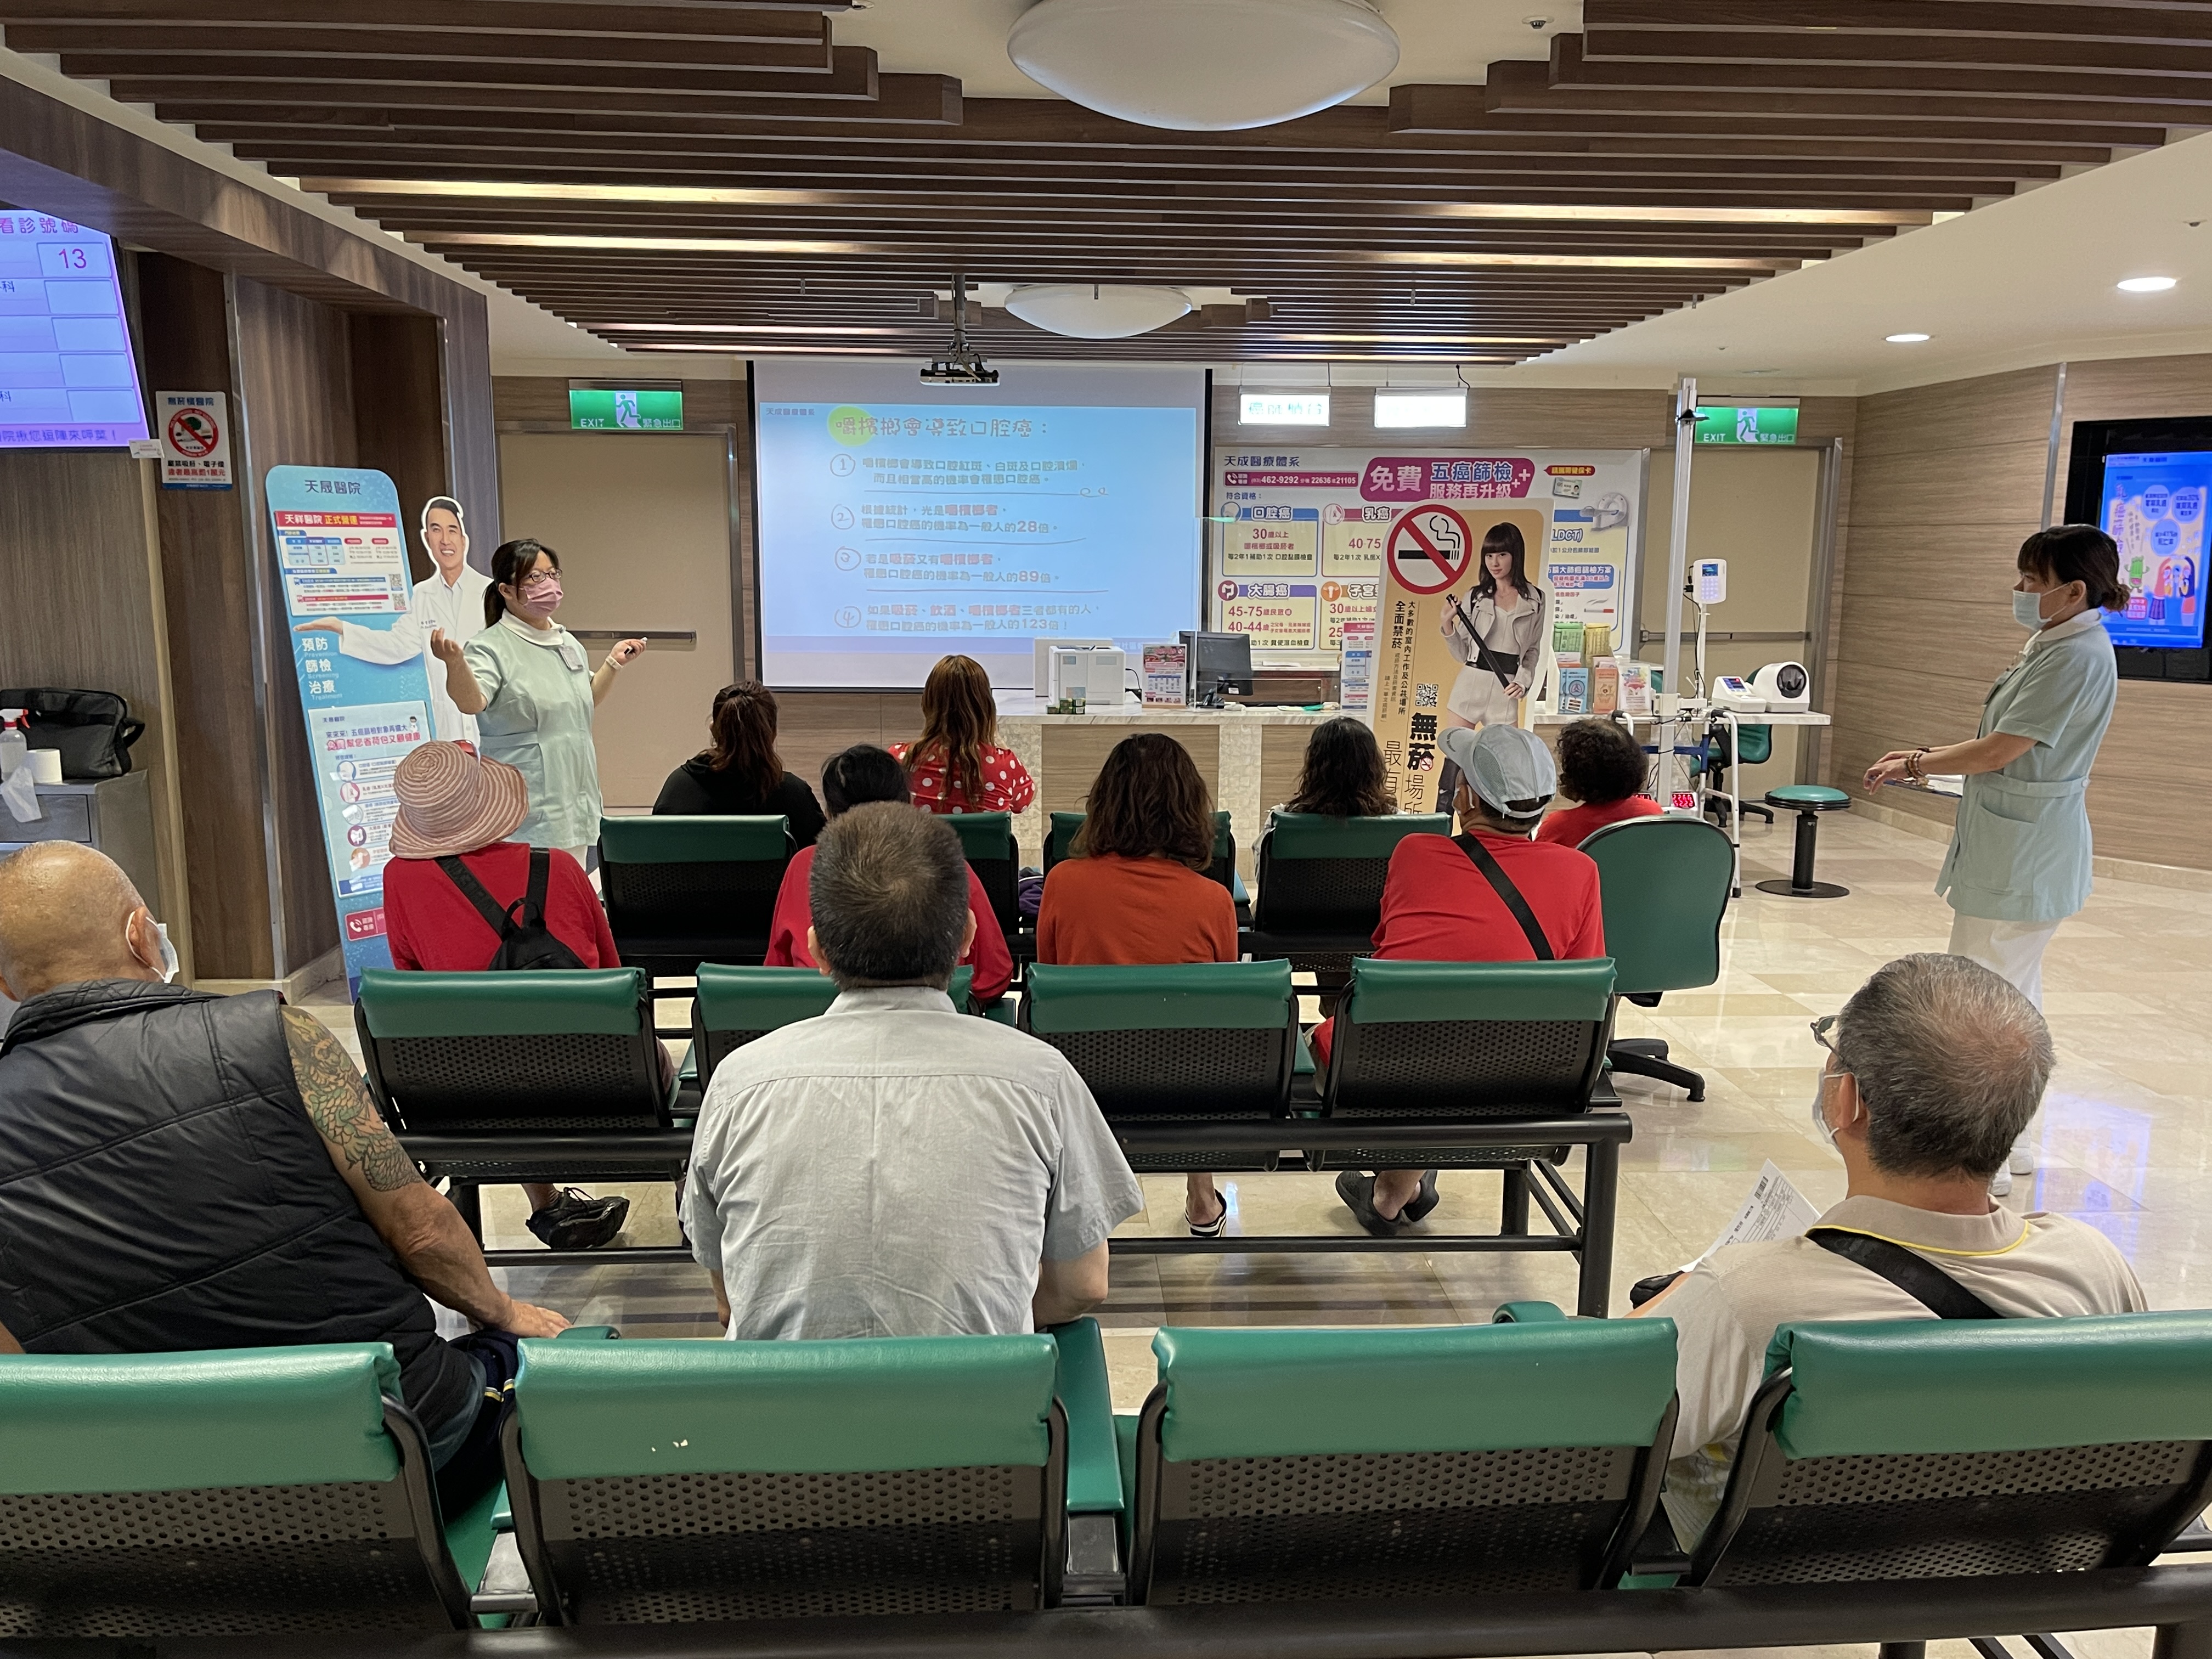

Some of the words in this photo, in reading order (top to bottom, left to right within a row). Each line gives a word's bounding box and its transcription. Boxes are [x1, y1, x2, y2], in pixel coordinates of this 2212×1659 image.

[59, 249, 87, 269] 13
[580, 419, 605, 428] EXIT
[642, 418, 681, 428] 緊急出口
[1703, 433, 1726, 442] EXIT
[1760, 433, 1795, 443] 緊急出口
[1224, 456, 1300, 467] 天成醫療體系
[1369, 465, 1423, 492] 免費
[1431, 461, 1513, 482] 五癌篩檢
[304, 480, 362, 495] 天晟醫院
[1430, 483, 1511, 499] 服務再升級
[1253, 505, 1291, 520] 口腔癌
[1364, 506, 1391, 521] 乳癌
[1252, 528, 1289, 539] 30歲以上
[1348, 538, 1381, 549] 40-75
[1249, 583, 1289, 597] 大腸癌
[1392, 601, 1406, 649] 全面禁菸
[302, 637, 329, 652] 預防
[305, 658, 332, 673] 篩檢
[309, 680, 336, 694] 治療
